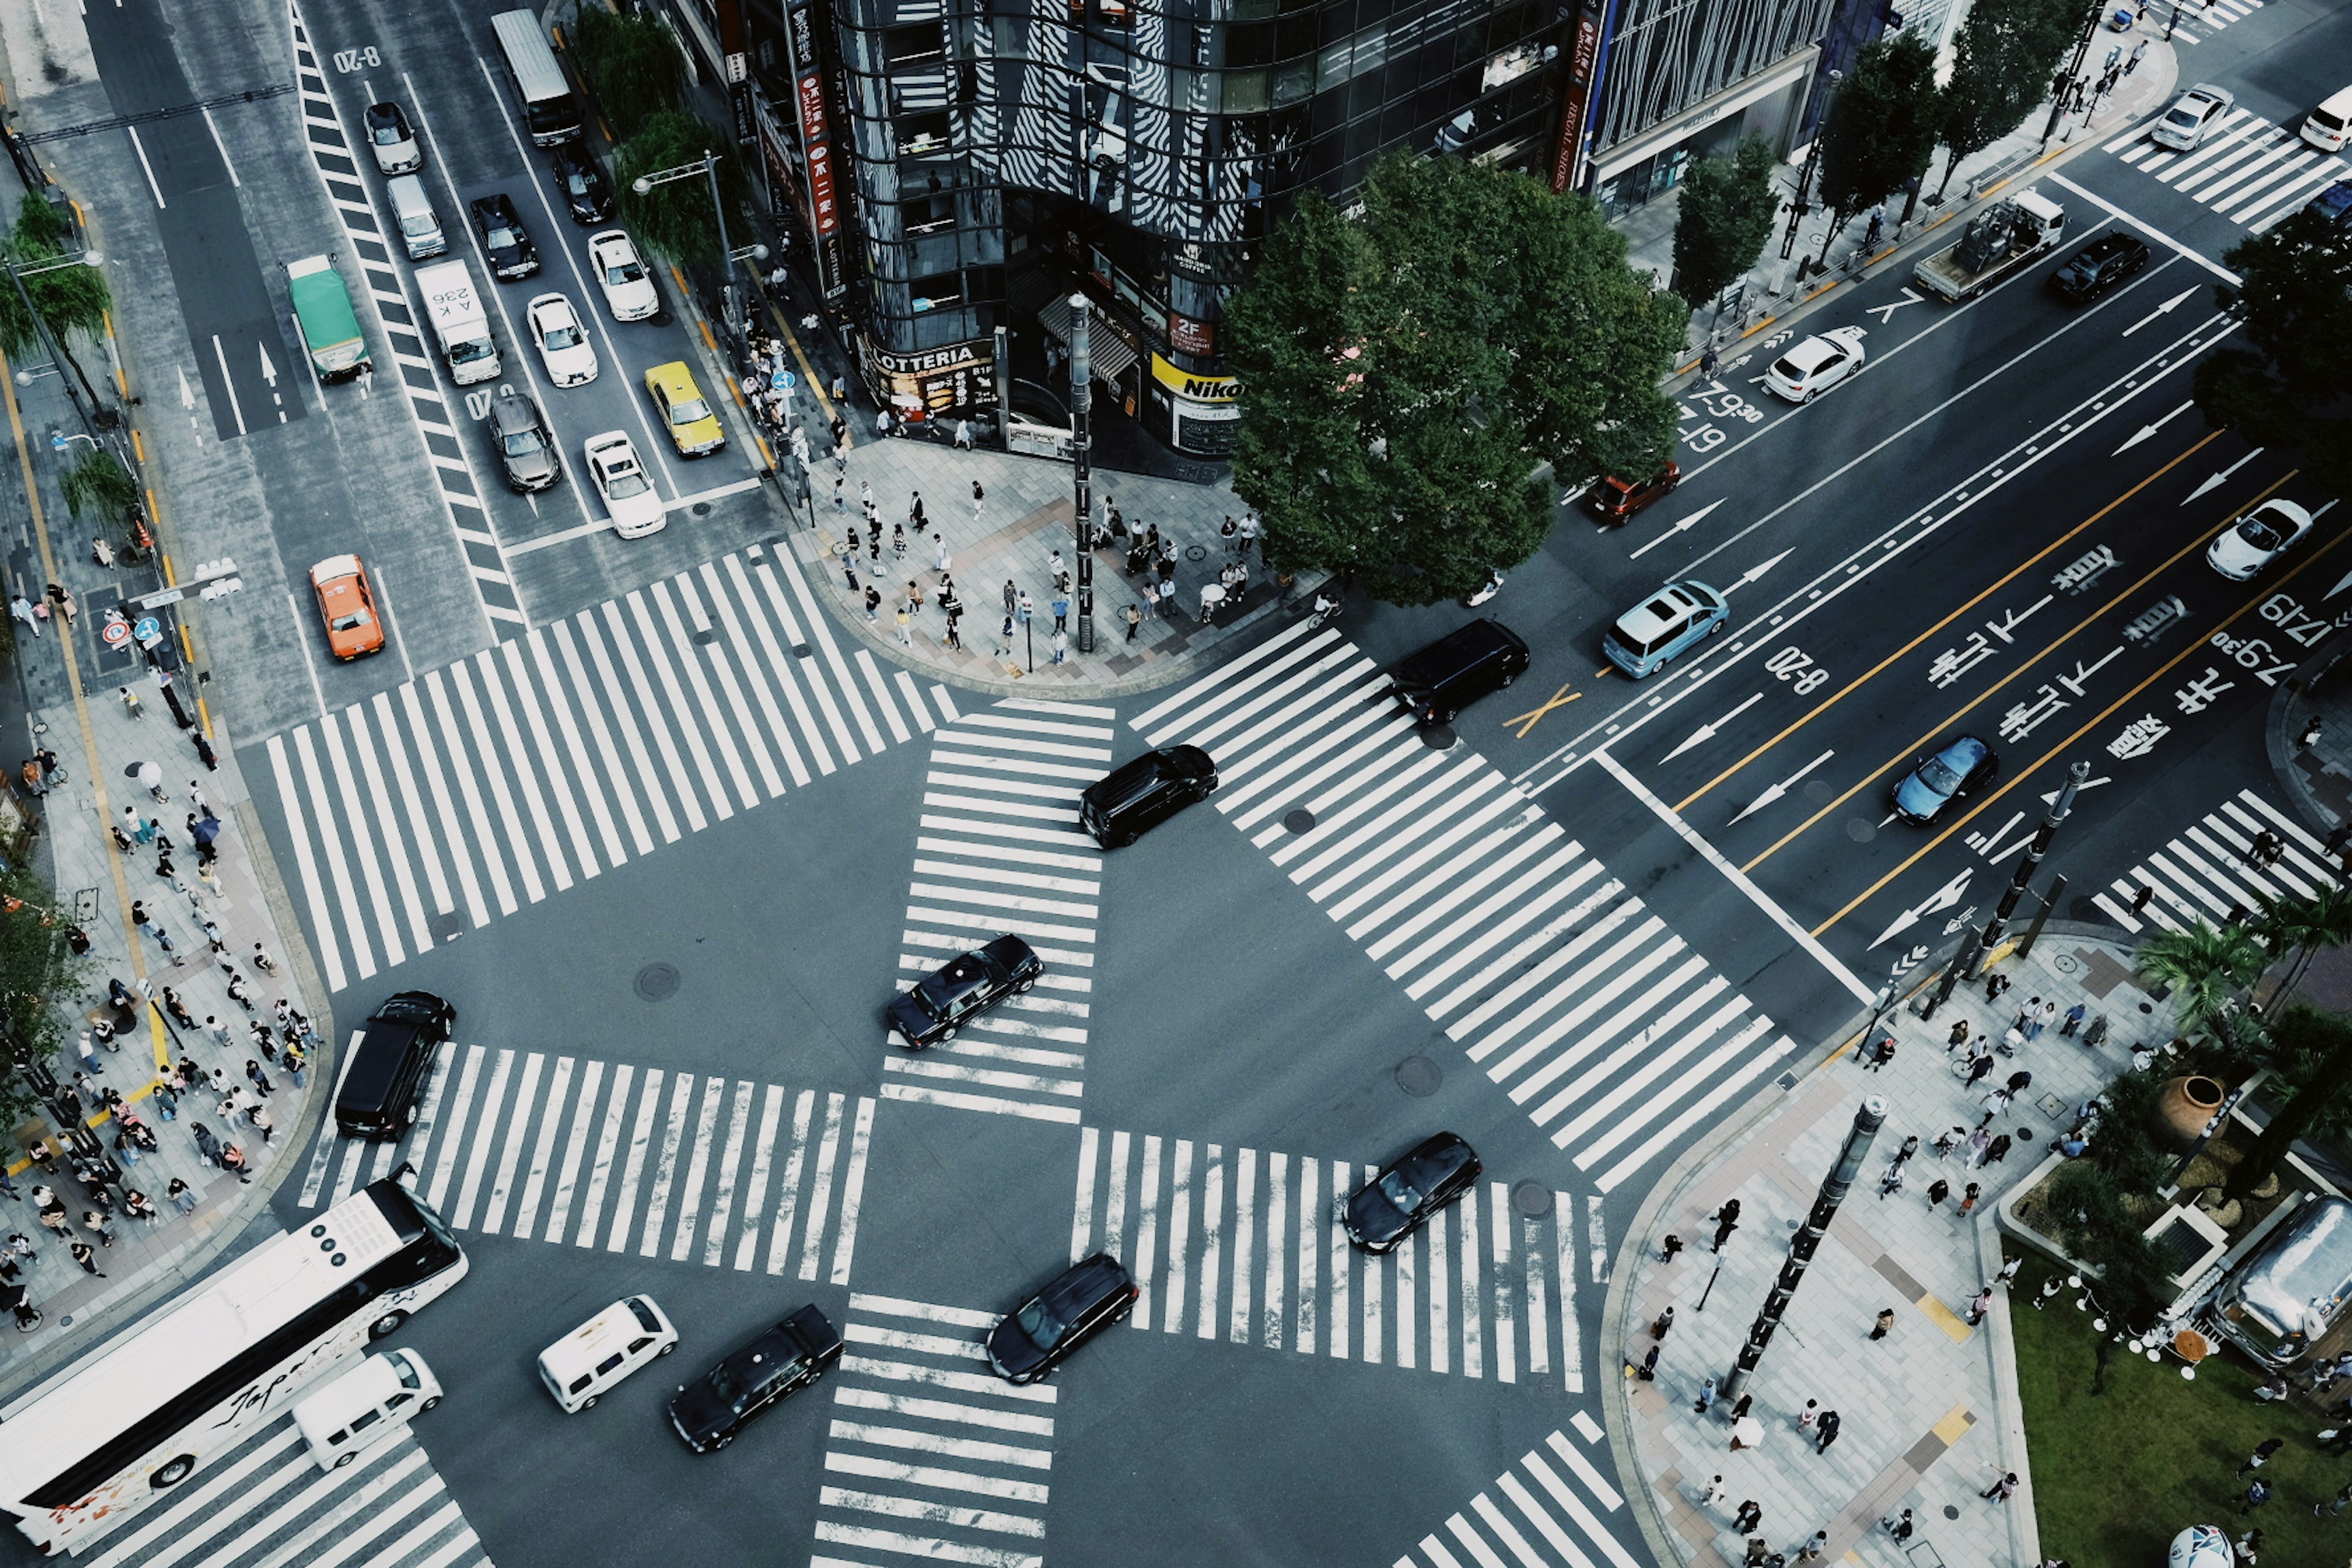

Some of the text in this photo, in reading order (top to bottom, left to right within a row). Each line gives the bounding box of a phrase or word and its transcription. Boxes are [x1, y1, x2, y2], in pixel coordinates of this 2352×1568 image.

[333, 45, 381, 74] 8-20
[809, 86, 823, 122] 不二家
[814, 161, 832, 214] 不二家
[1178, 318, 1200, 334] 2F
[873, 347, 974, 372] LOTTERIA
[1184, 379, 1247, 398] Niko
[2259, 594, 2334, 648] 17-19
[1765, 646, 1830, 695] 8-20
